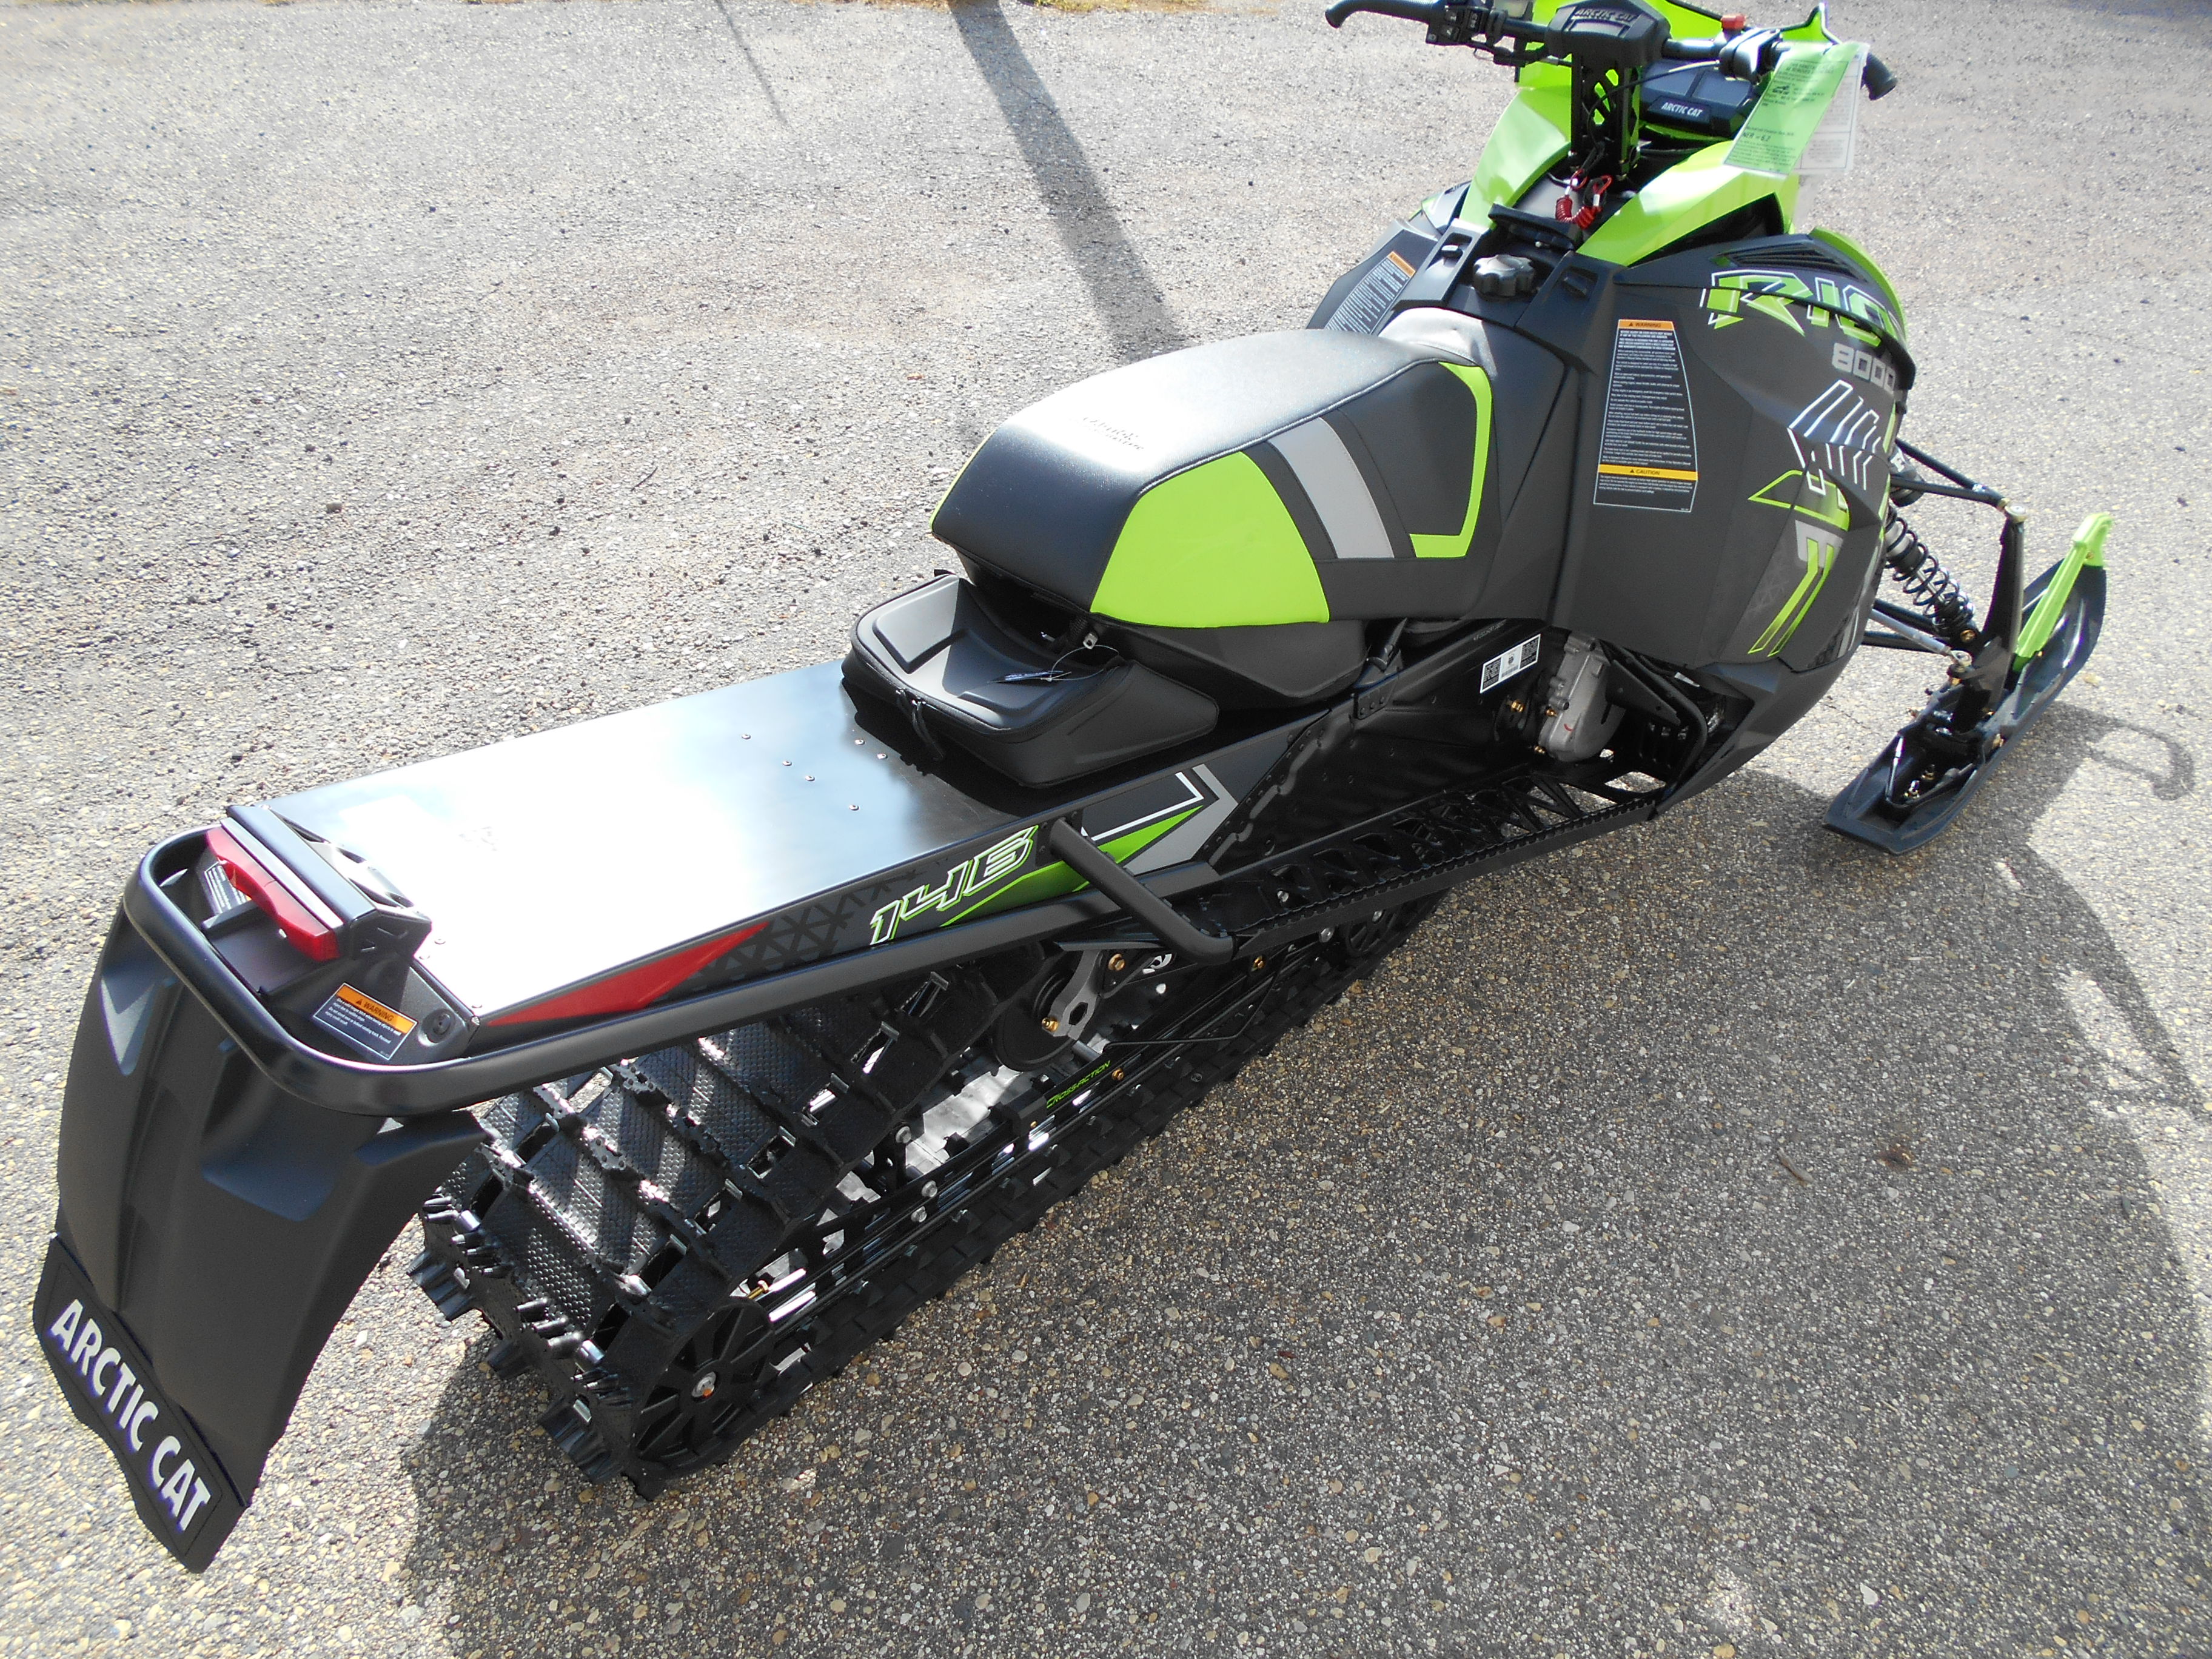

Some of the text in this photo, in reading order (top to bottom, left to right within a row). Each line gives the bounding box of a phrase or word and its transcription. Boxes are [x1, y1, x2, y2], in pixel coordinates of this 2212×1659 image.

[1575, 8, 1637, 22] ARCTIC CAT
[1661, 102, 1703, 118] ARCTIC CAT
[1700, 269, 1904, 347] RIO
[1832, 343, 1896, 395] 8000
[363, 1002, 394, 1022] WARNING
[51, 1299, 211, 1530] ARCTIC CAT
